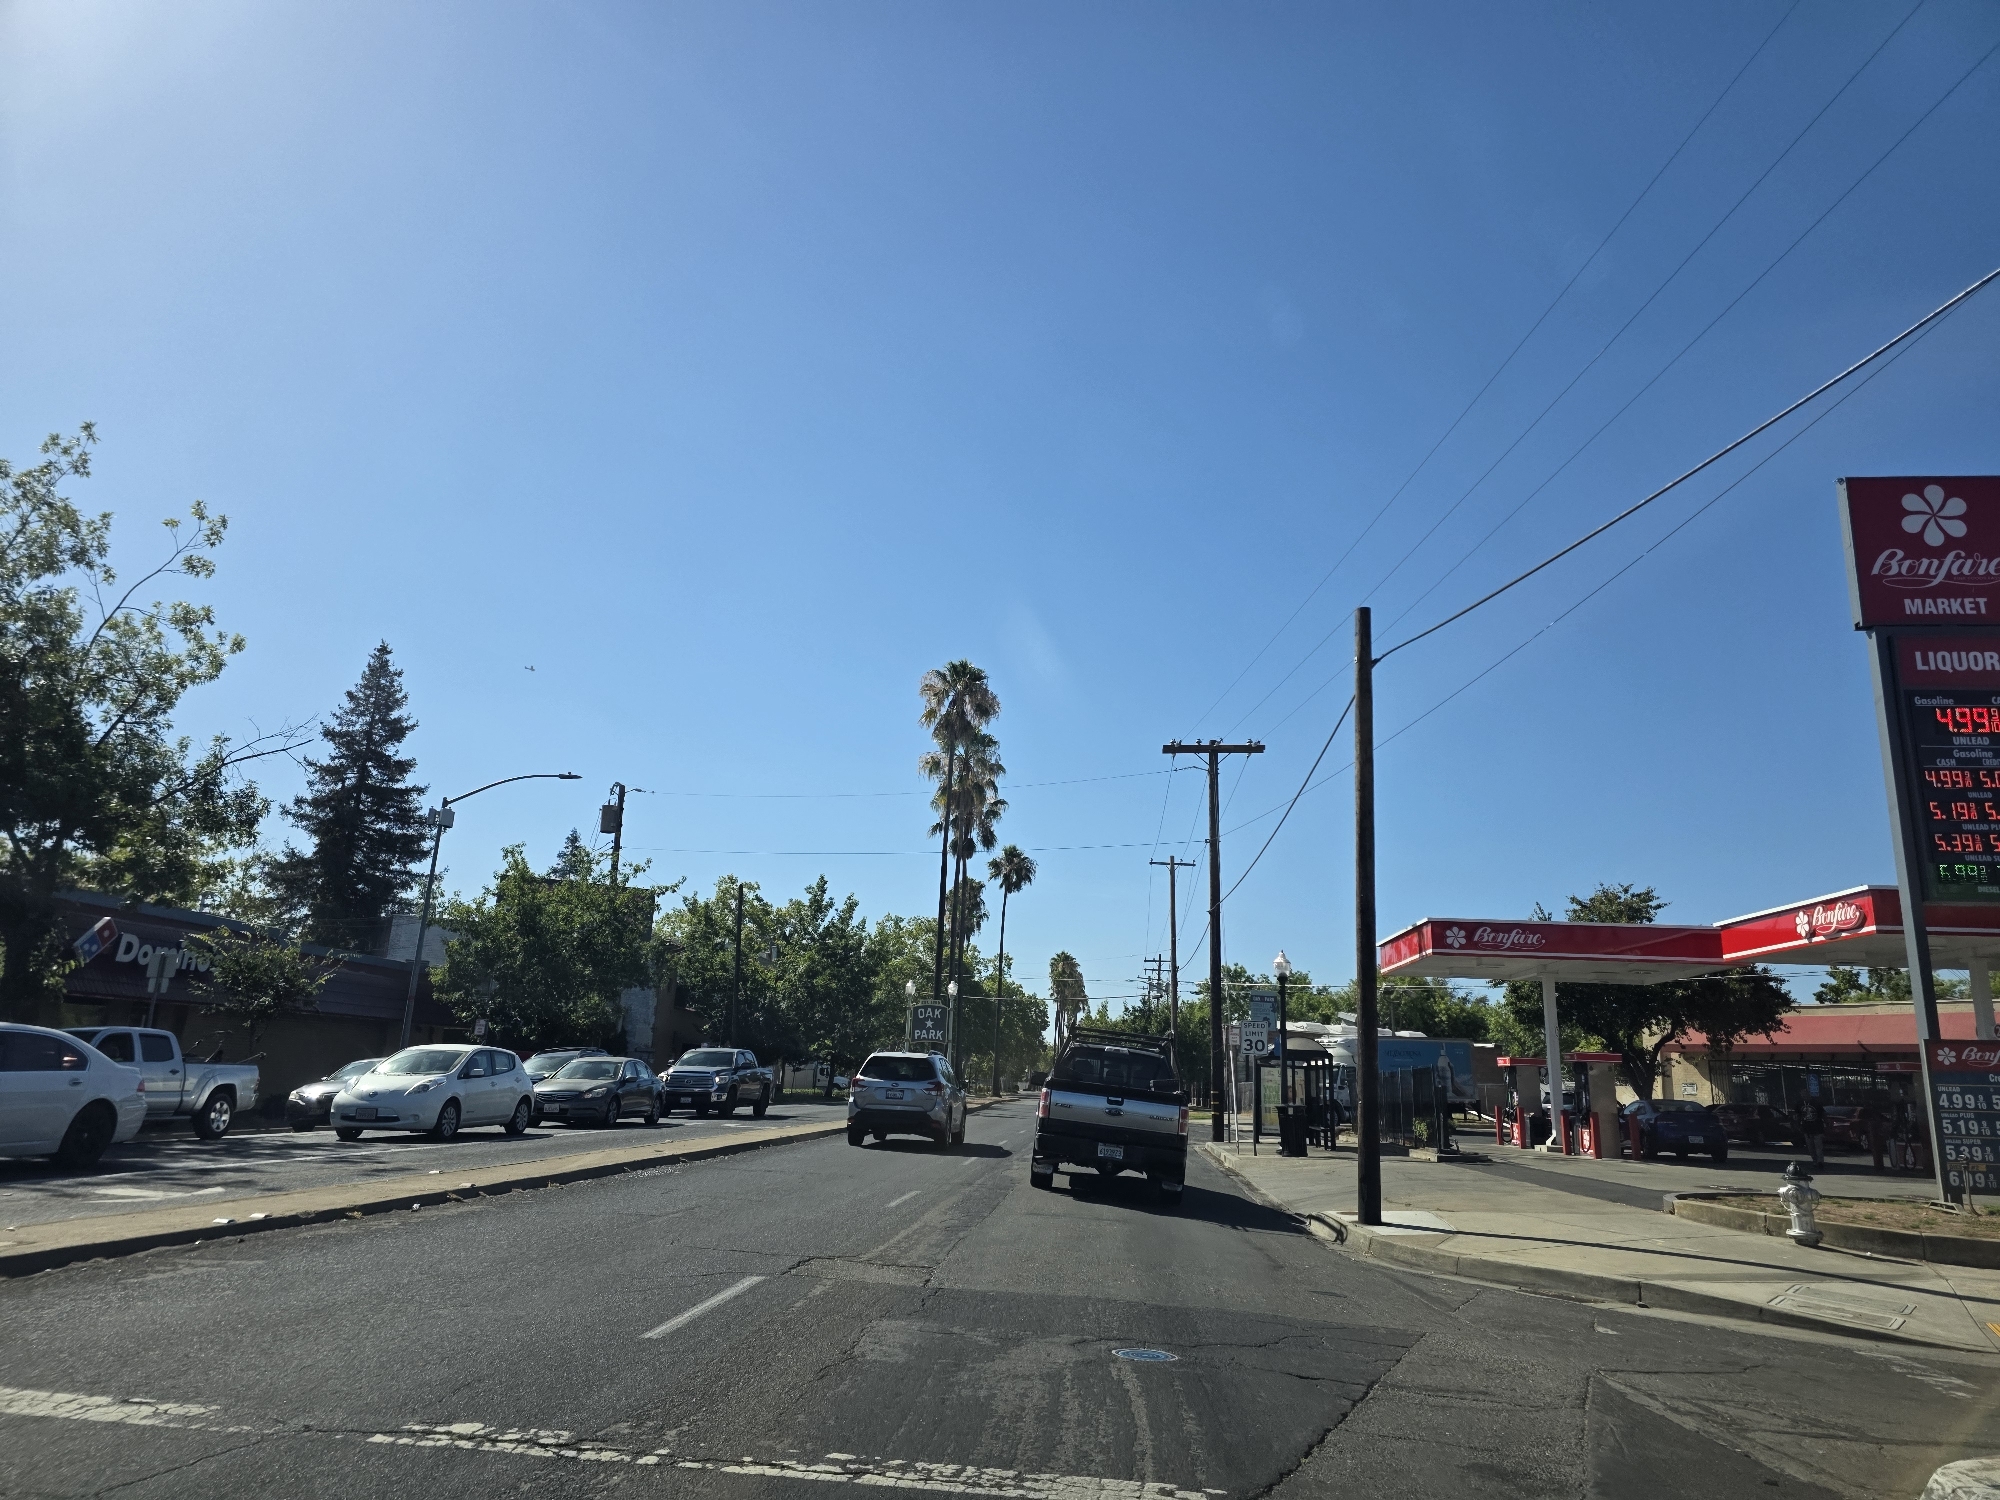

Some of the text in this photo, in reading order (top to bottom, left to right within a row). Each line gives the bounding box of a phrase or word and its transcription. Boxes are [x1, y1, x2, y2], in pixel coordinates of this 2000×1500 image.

[1904, 597, 1988, 615] MARKET
[1914, 651, 2000, 673] LIQUOR
[1914, 696, 1954, 705] Gasoline
[1935, 707, 1990, 733] 4.99
[1953, 736, 1990, 745] UNLEAD
[1953, 748, 1993, 758] Gasoline
[1936, 758, 1956, 766] CASH
[1925, 770, 1964, 788] 4.99
[1967, 791, 1993, 799] UNLEAD
[1929, 801, 1969, 820] 5.19
[1962, 823, 1989, 831] UNLEAD
[1934, 833, 1974, 852] 5.39
[1812, 902, 1860, 933] Bonfare
[1473, 926, 1545, 950] Bonfare
[918, 1007, 942, 1019] OAK
[914, 1029, 944, 1041] PARK
[1243, 1038, 1266, 1052] 30
[1939, 1093, 1976, 1109] 4.99
[1942, 1119, 1979, 1135] 5.19
[1945, 1145, 1982, 1162] 539
